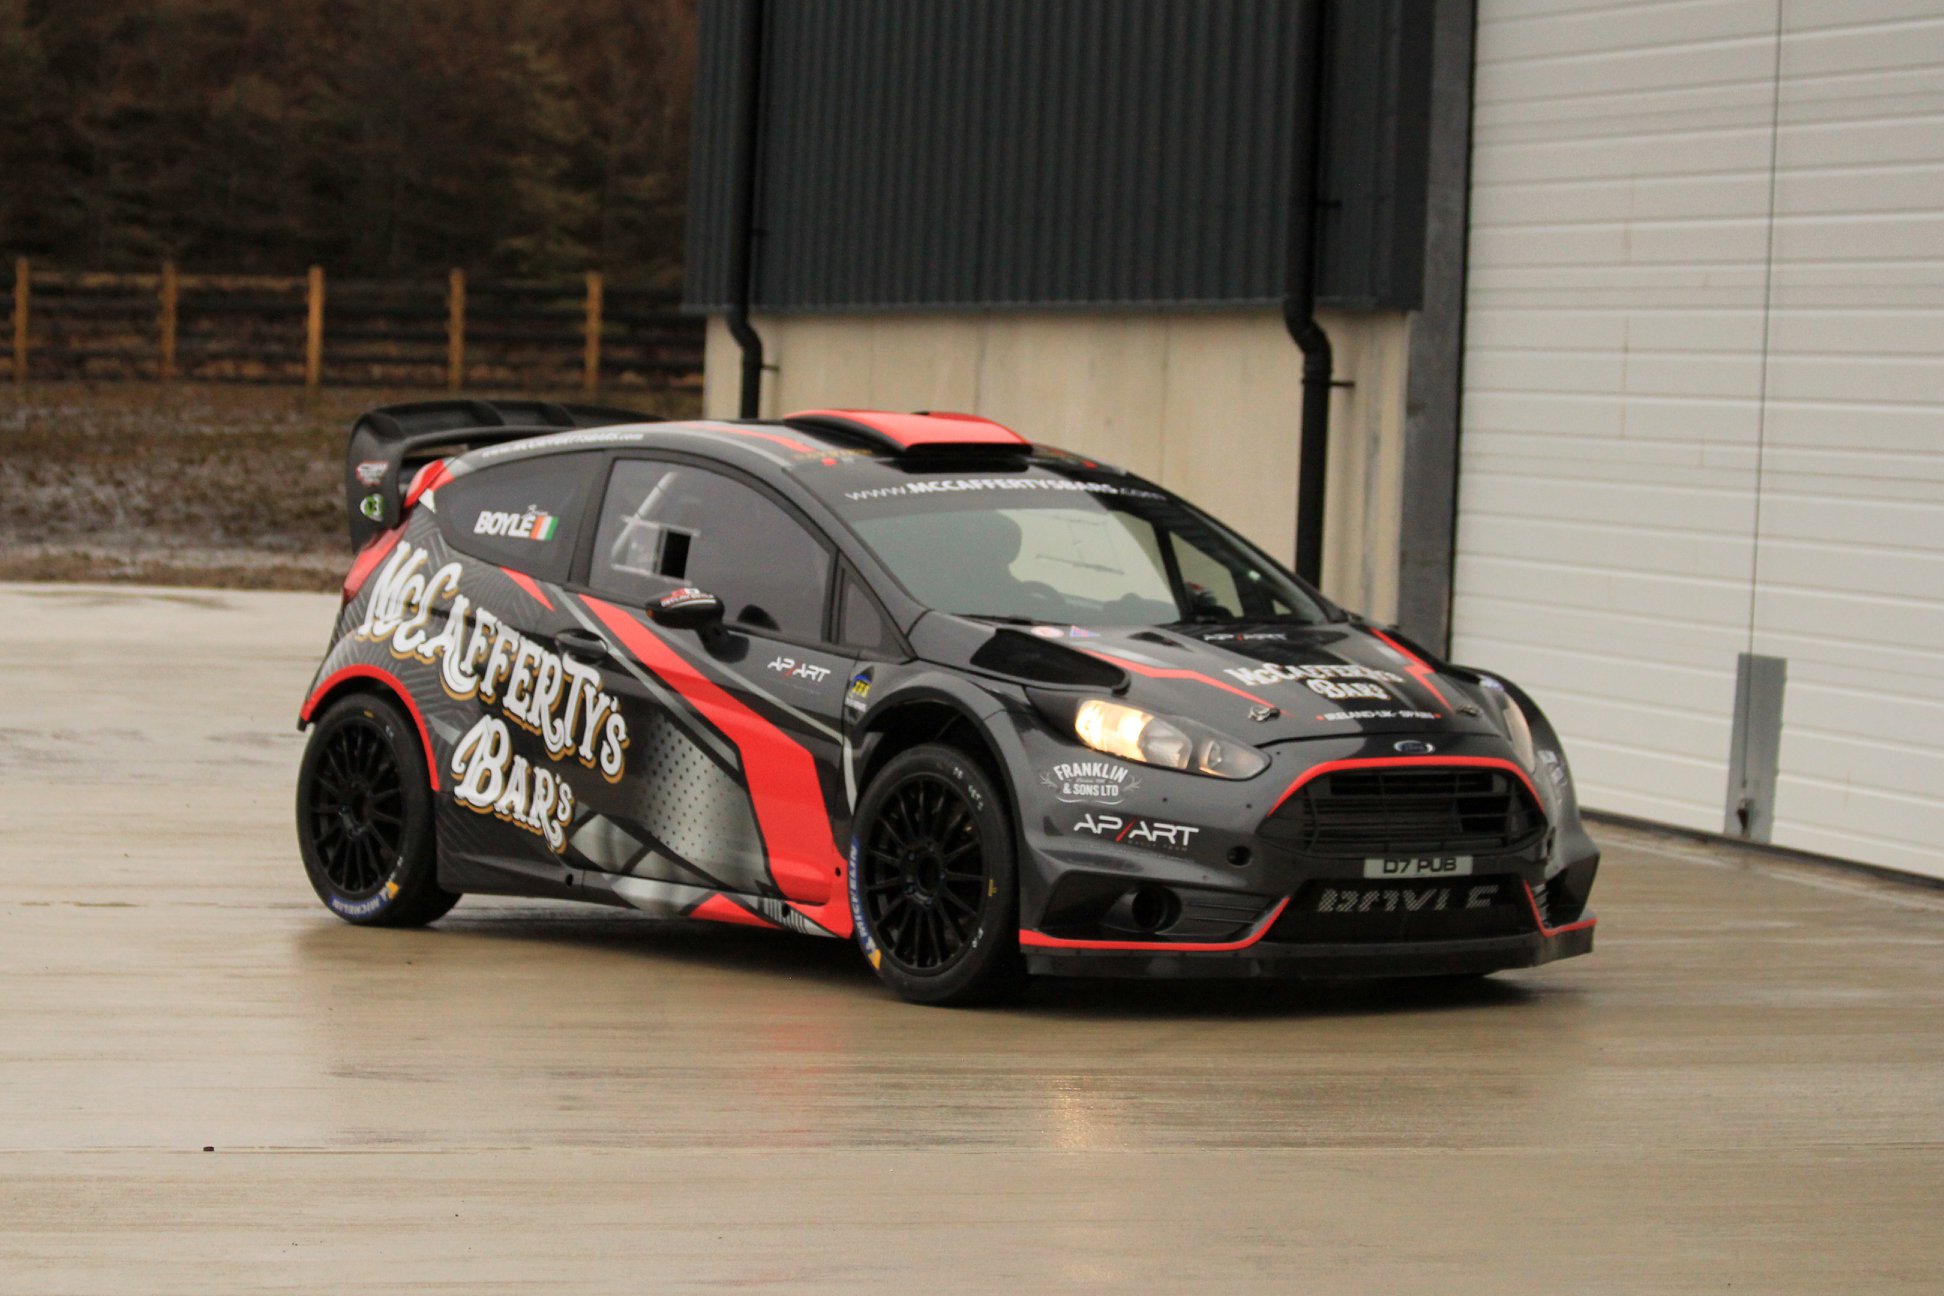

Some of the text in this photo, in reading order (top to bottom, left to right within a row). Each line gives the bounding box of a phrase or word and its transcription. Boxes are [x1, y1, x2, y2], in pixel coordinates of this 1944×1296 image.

[474, 510, 537, 538] BOYLE
[1053, 761, 1129, 783] FRANKLIN
[1062, 783, 1119, 797] & SONS LTD
[1383, 857, 1457, 874] D7 PUB
[849, 845, 868, 939] MICHELIN
